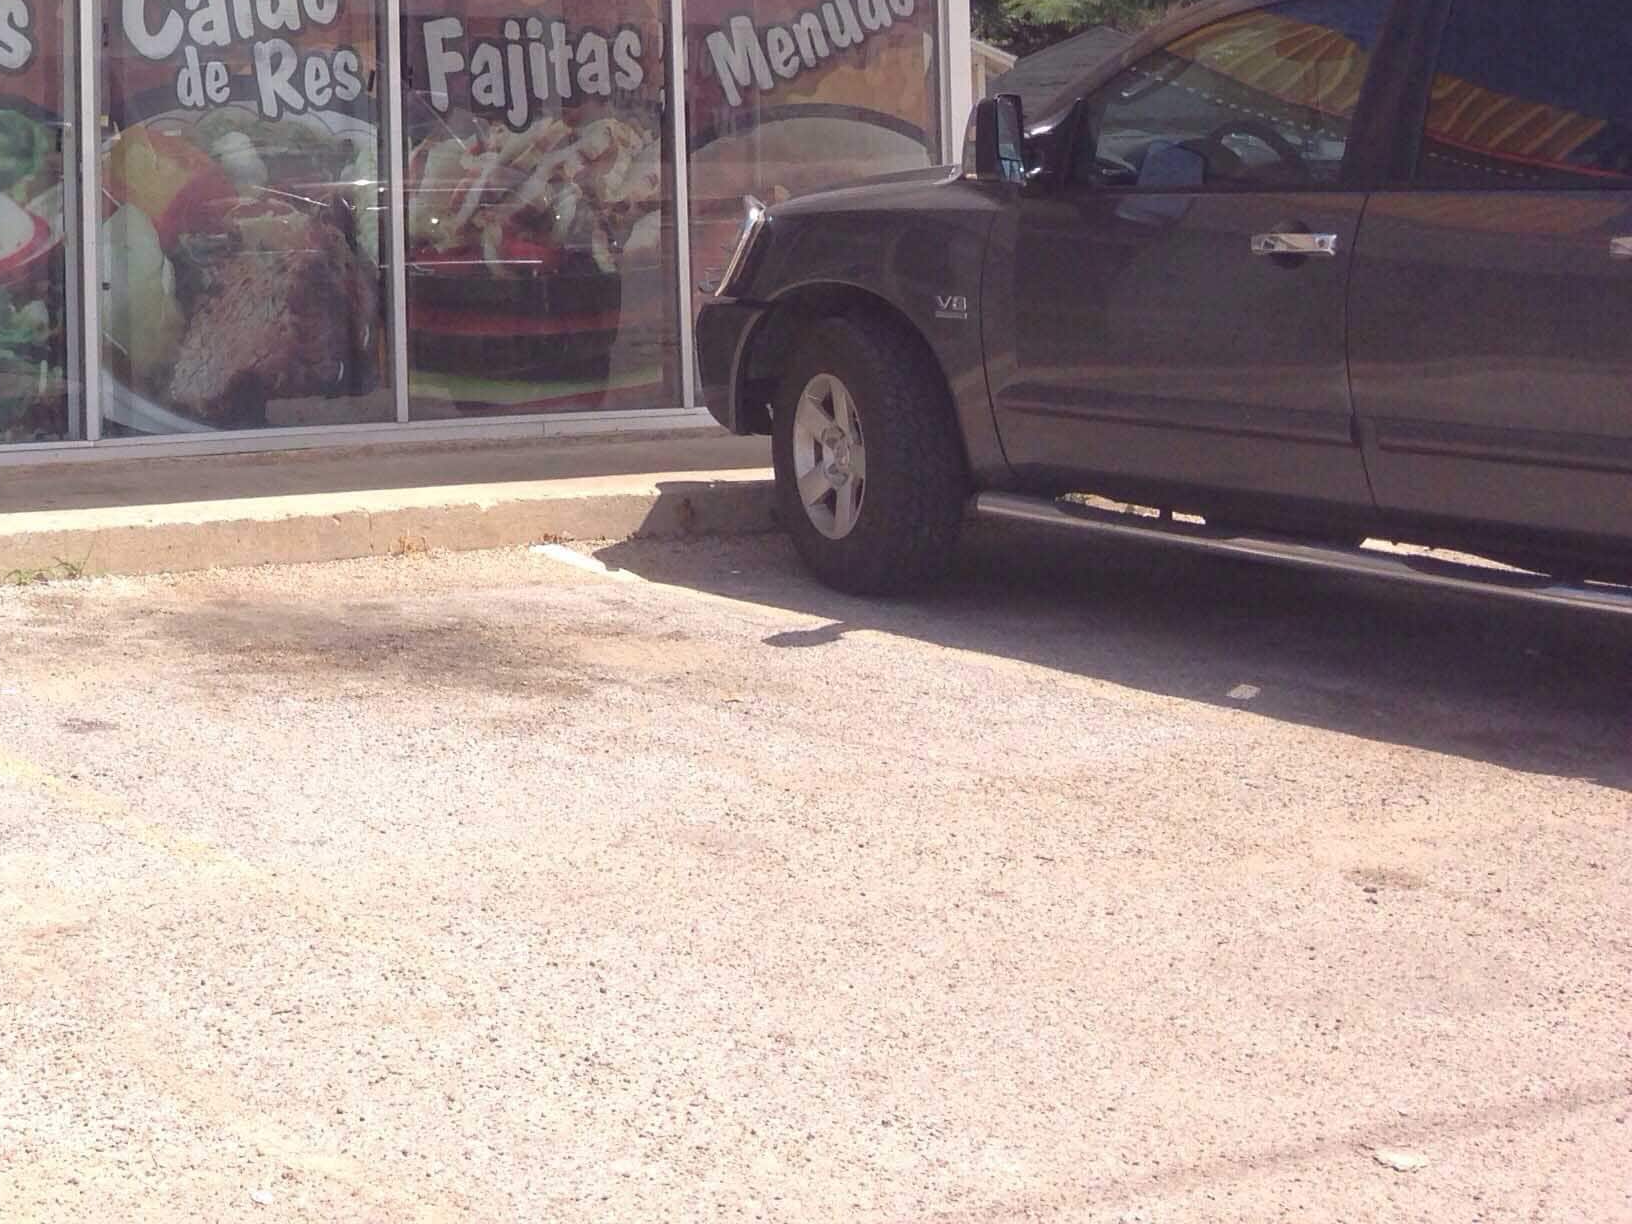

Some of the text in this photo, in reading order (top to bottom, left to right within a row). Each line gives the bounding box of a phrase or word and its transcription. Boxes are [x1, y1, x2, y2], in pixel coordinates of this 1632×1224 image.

[176, 37, 363, 119] de Res
[422, 15, 645, 127] Fajitas
